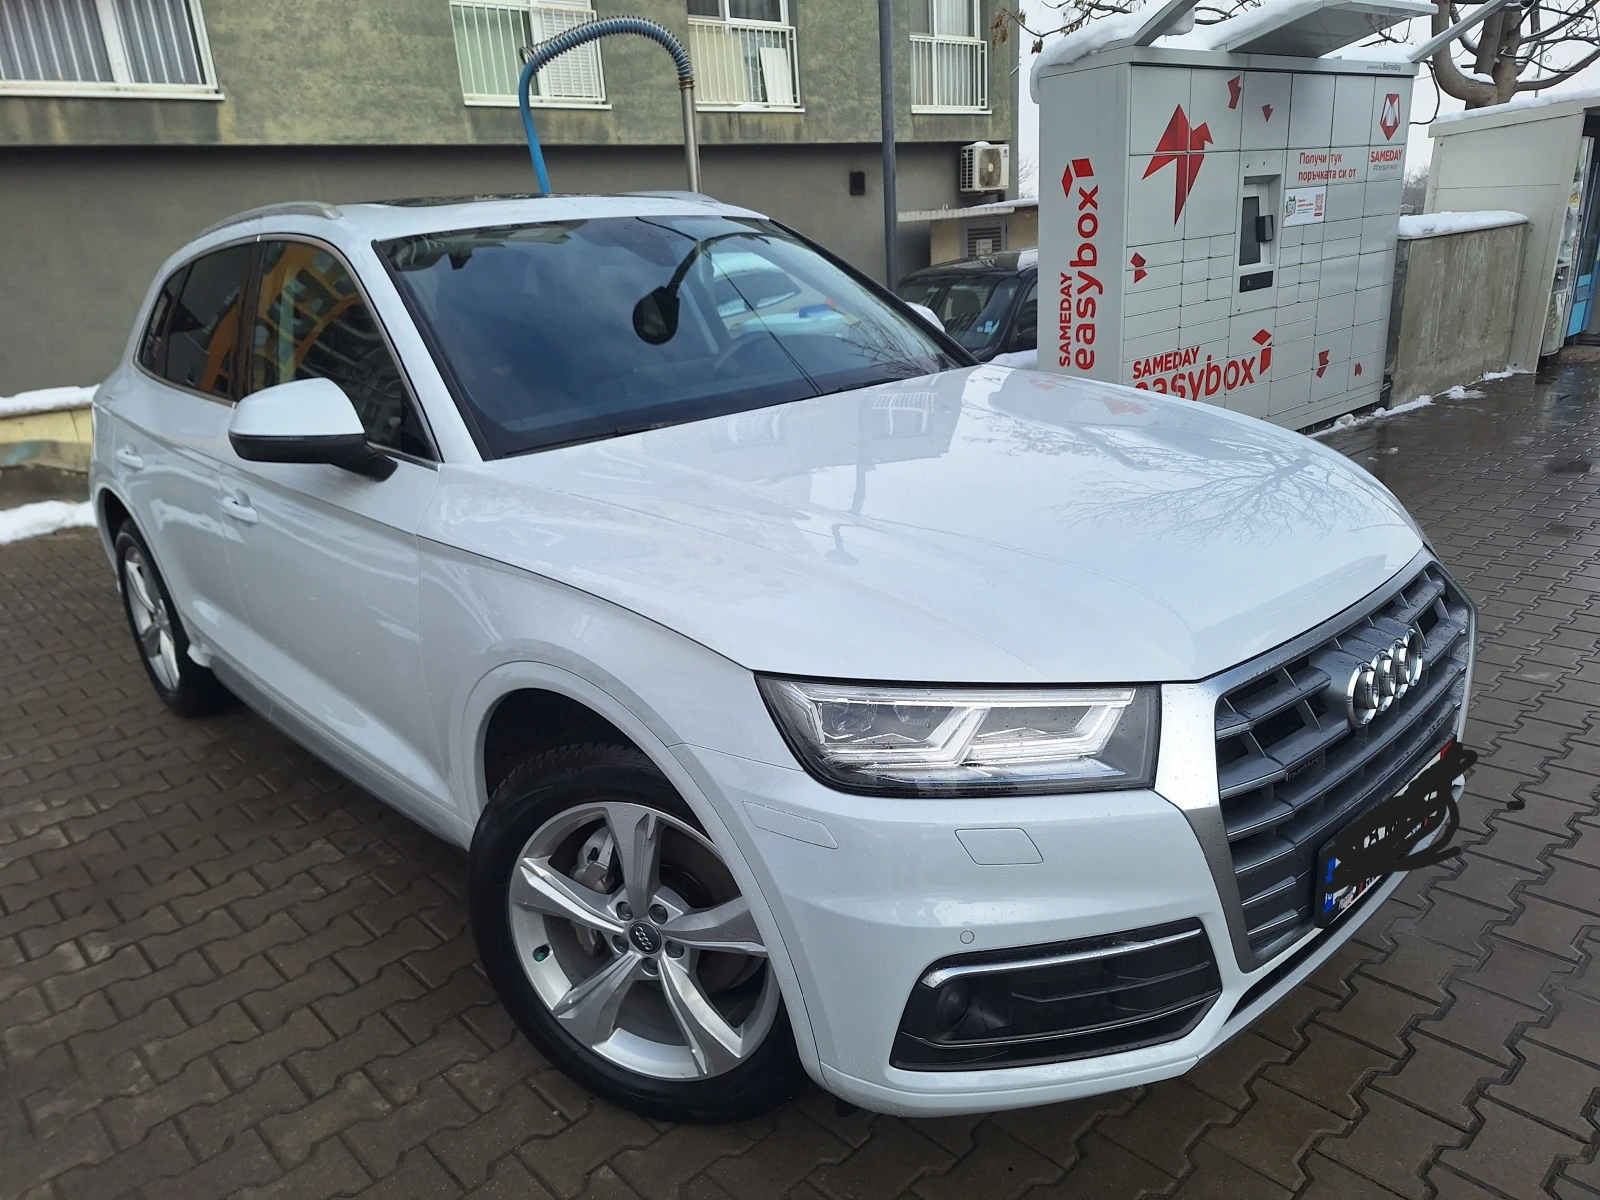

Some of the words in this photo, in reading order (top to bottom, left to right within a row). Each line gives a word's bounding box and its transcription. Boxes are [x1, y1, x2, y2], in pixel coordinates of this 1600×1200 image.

[1299, 152, 1327, 167] Получи
[1330, 152, 1342, 165] тук
[1370, 149, 1403, 163] SAMEDAY
[1298, 170, 1337, 183] поръчката
[1338, 169, 1347, 178] си
[1348, 168, 1357, 178] от
[1069, 184, 1104, 370] easybox
[1059, 272, 1072, 367] SAMEDAY
[1132, 346, 1200, 380] SAMEDAY
